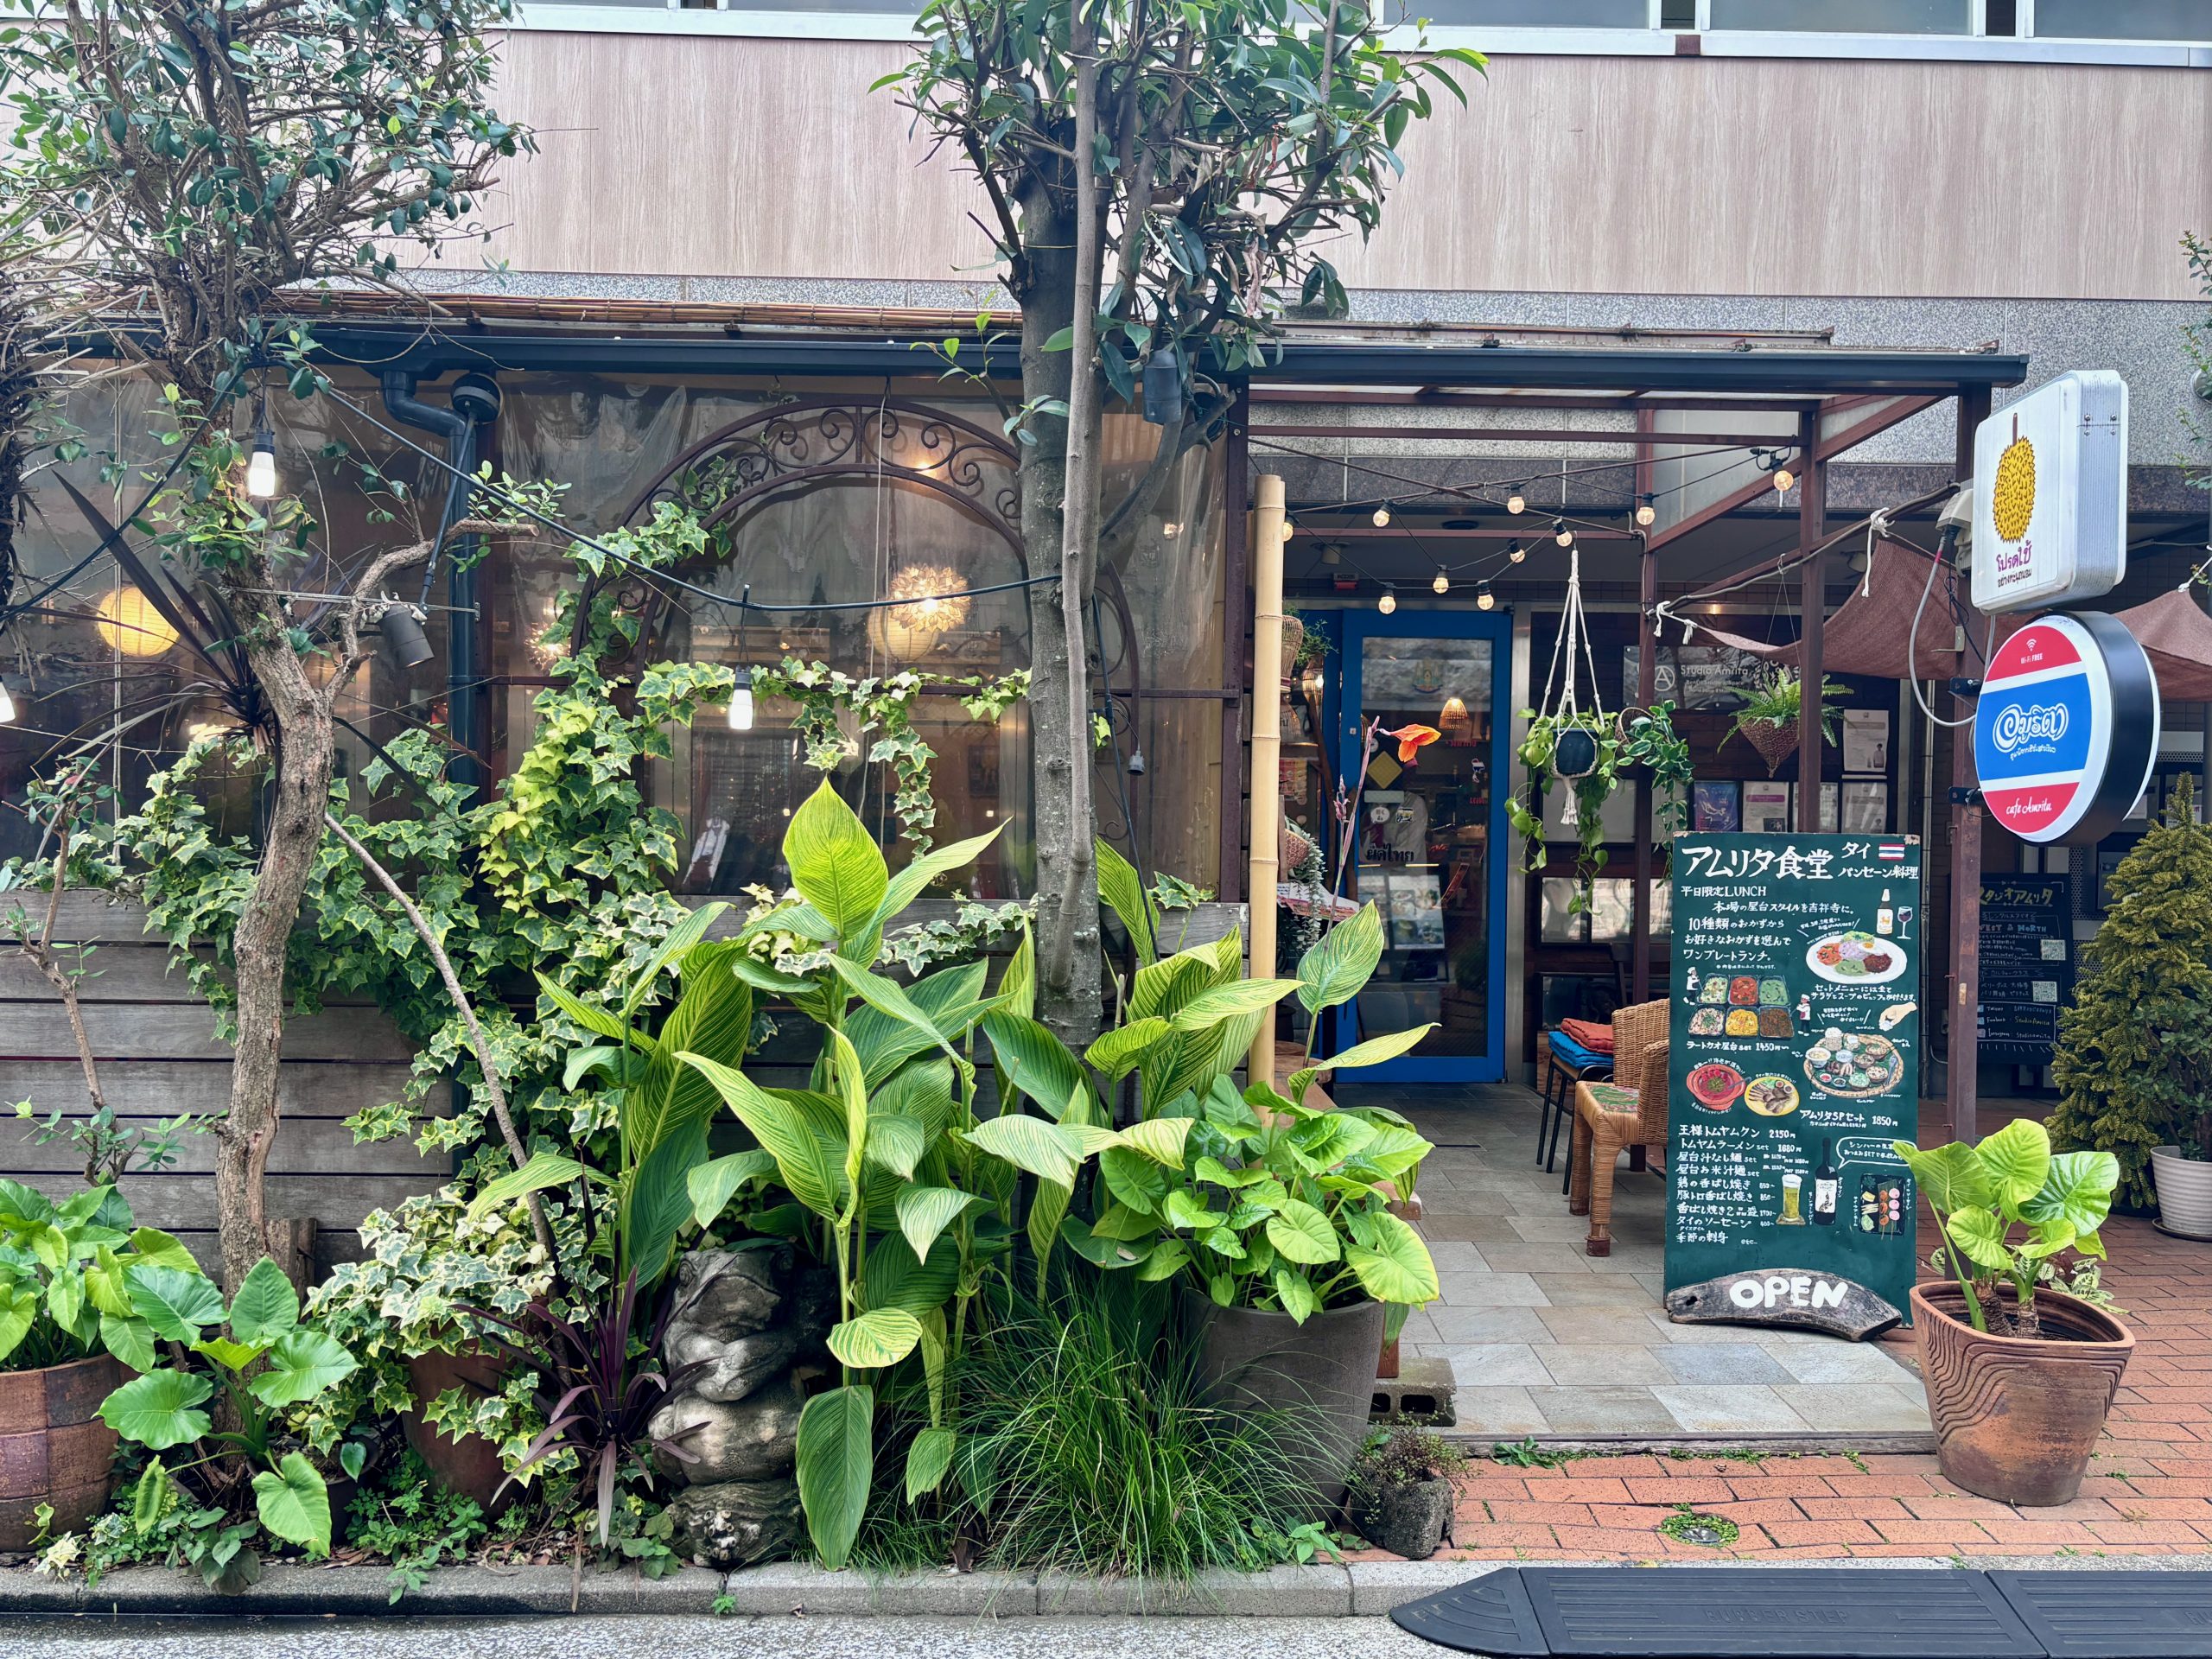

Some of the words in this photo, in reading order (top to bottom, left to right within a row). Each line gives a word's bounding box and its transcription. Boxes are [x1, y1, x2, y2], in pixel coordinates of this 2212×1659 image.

[1996, 540, 2032, 572] โปรดใช้
[2020, 655, 2031, 664] Wi-Fi
[2031, 652, 2043, 662] FREE
[1681, 664, 1712, 675] Studio
[1714, 666, 1749, 676] Amrita
[2005, 798, 2022, 818] cafe
[2022, 796, 2053, 814] Amrita
[1841, 842, 1872, 859] タイ
[1681, 845, 1834, 880] アムリタ食堂
[1681, 886, 1767, 898] 平日限定LUNCH
[1688, 917, 1785, 931] 10種類のおかずから
[1684, 934, 1792, 947] お好きなおかずを選んで
[1799, 1109, 1865, 1123] アムリタSPセット
[1872, 1115, 1898, 1127] 1850円
[1678, 1123, 1760, 1138] 王様トムヤムクン
[1769, 1128, 1796, 1139] 2150円
[1681, 1137, 1755, 1150] トムヤムラーメン
[1676, 1151, 1743, 1164] 屋台汁なし麺
[1676, 1190, 1753, 1203] 豚トロ香ばし焼き
[1675, 1217, 1752, 1229] タイのソーセージ
[1676, 1230, 1729, 1244] 季節の刺身
[1729, 1275, 1849, 1309] OPEN
[1703, 1608, 1790, 1624] RUBBER
[1793, 1609, 1849, 1624] STEP
